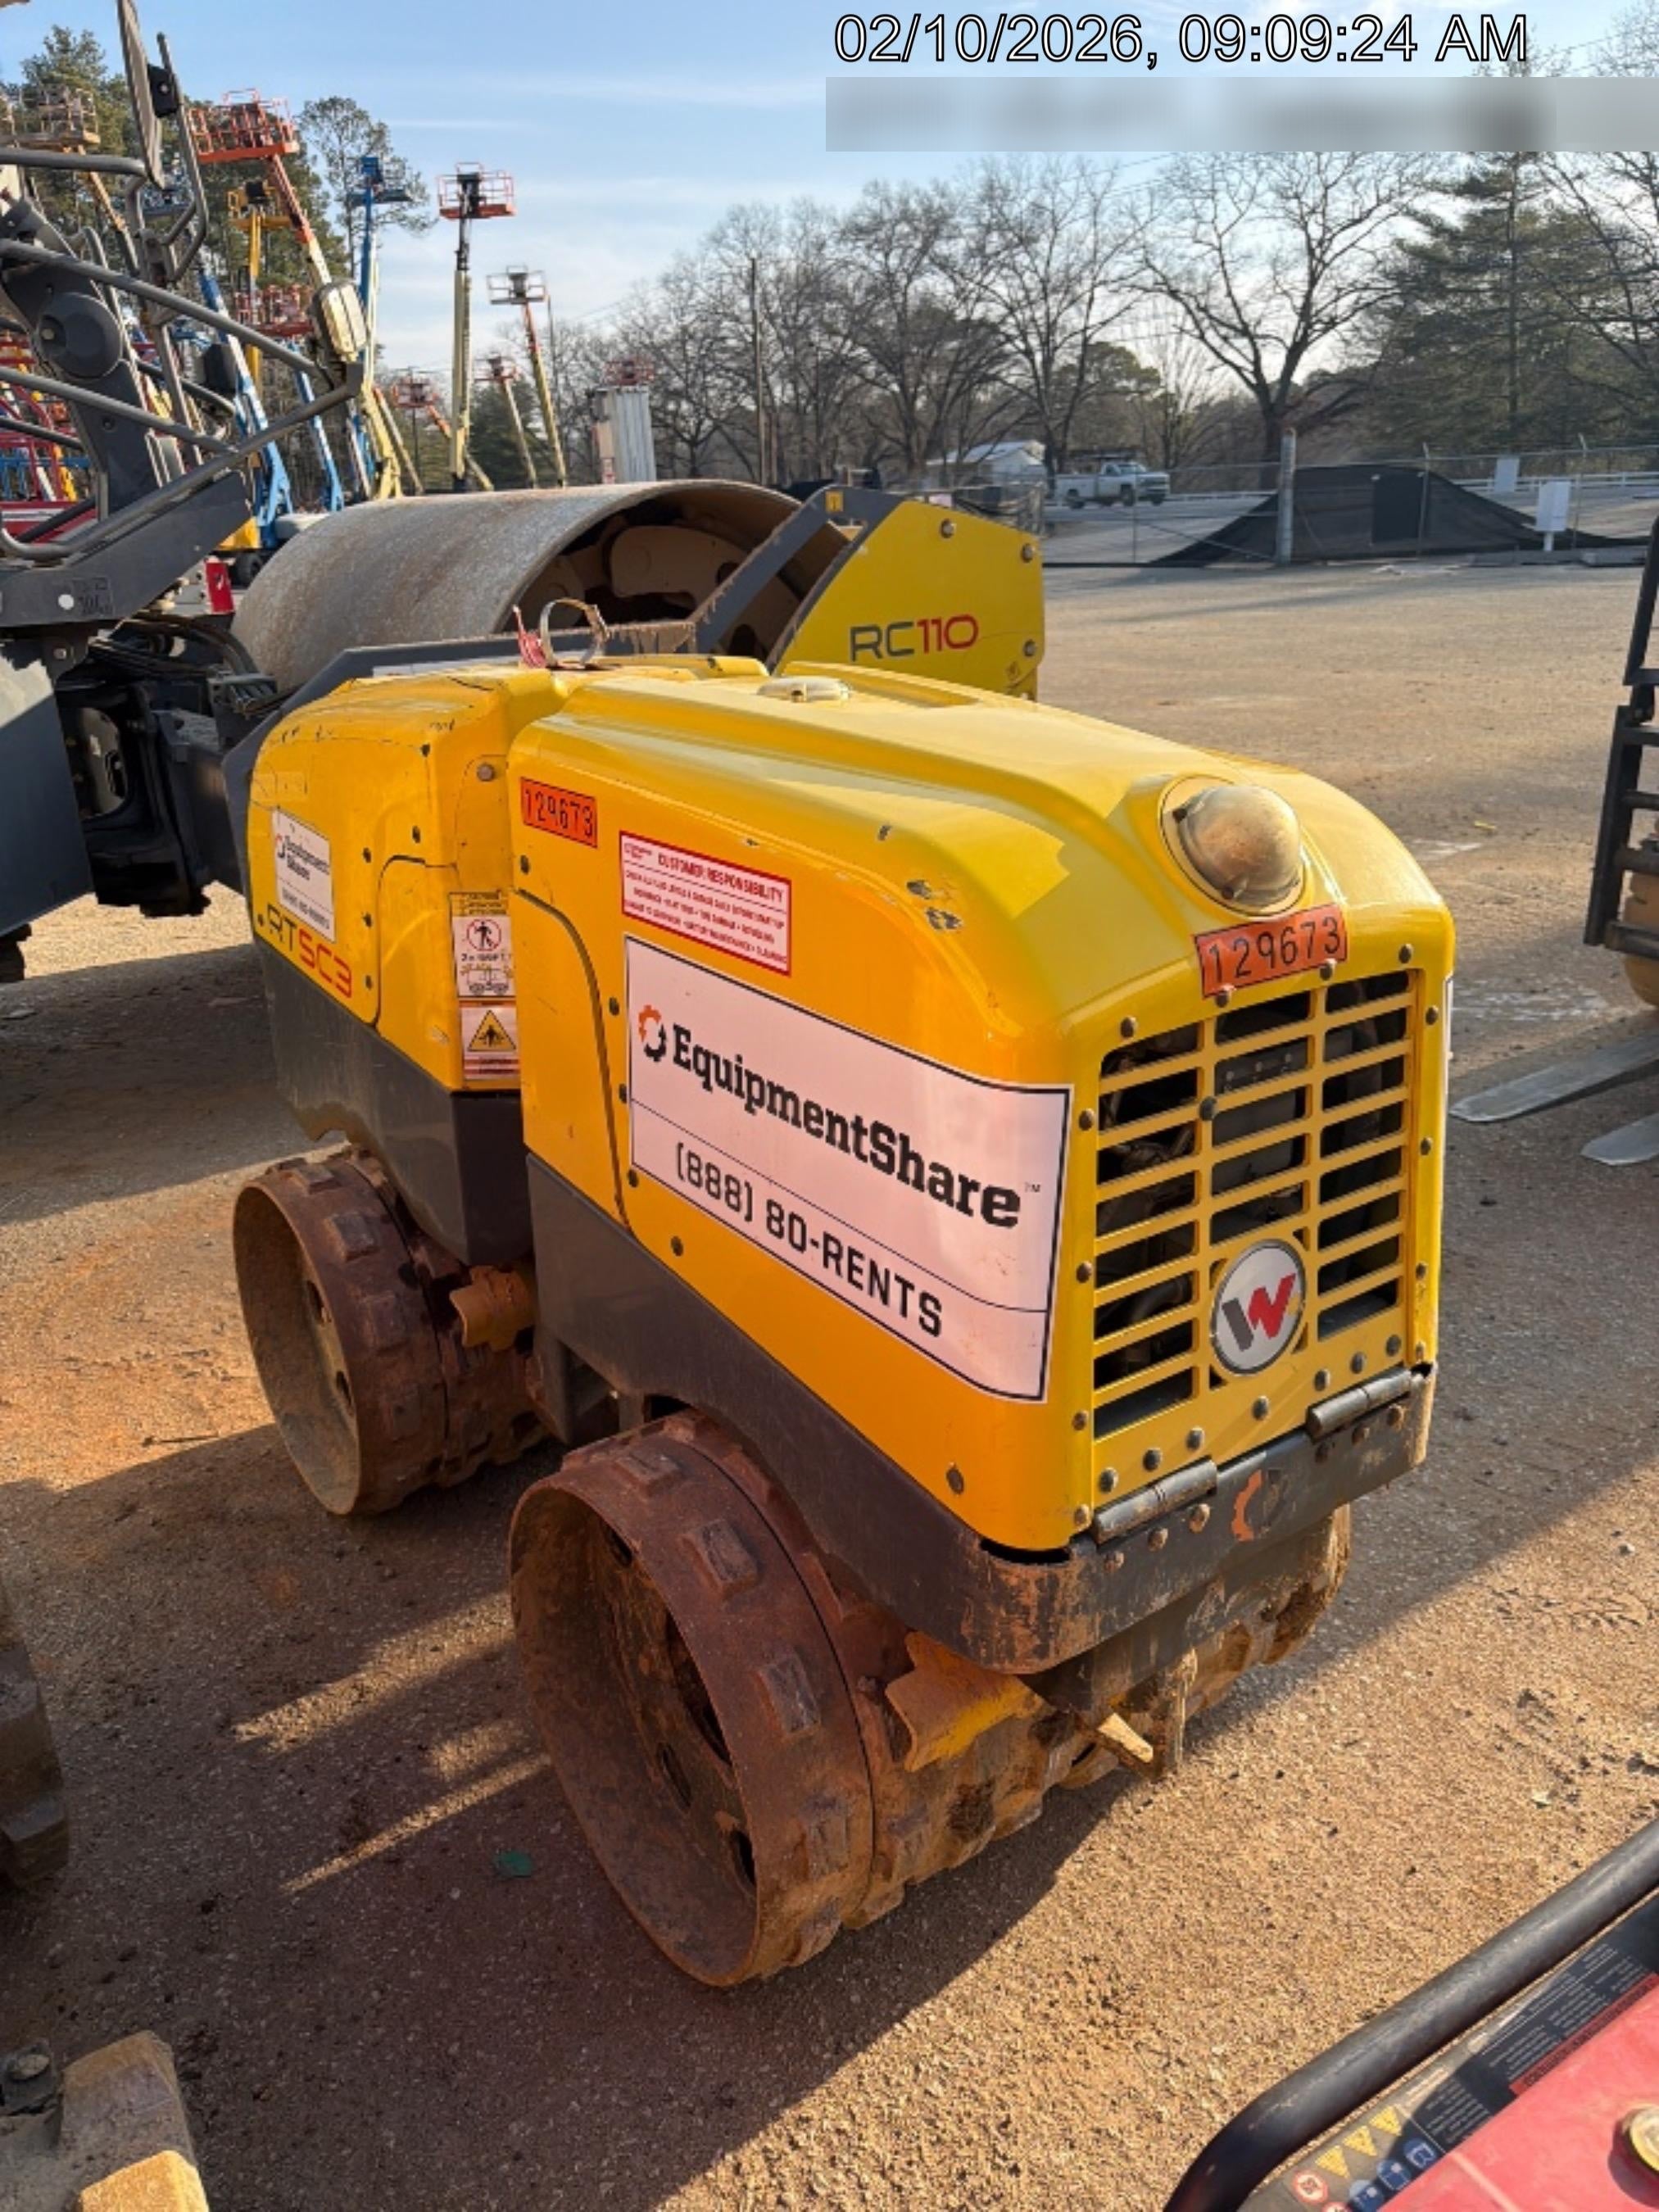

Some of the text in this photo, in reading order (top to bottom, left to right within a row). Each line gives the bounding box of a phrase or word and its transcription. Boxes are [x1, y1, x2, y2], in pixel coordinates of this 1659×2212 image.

[850, 614, 979, 663] RC110
[525, 788, 593, 839] 129673
[707, 866, 784, 903] RESPONSIBILITY
[1208, 916, 1341, 983] 129673
[672, 1022, 1022, 1230] EquipmentShare
[675, 1142, 944, 1339] (888) 80-RENTS
